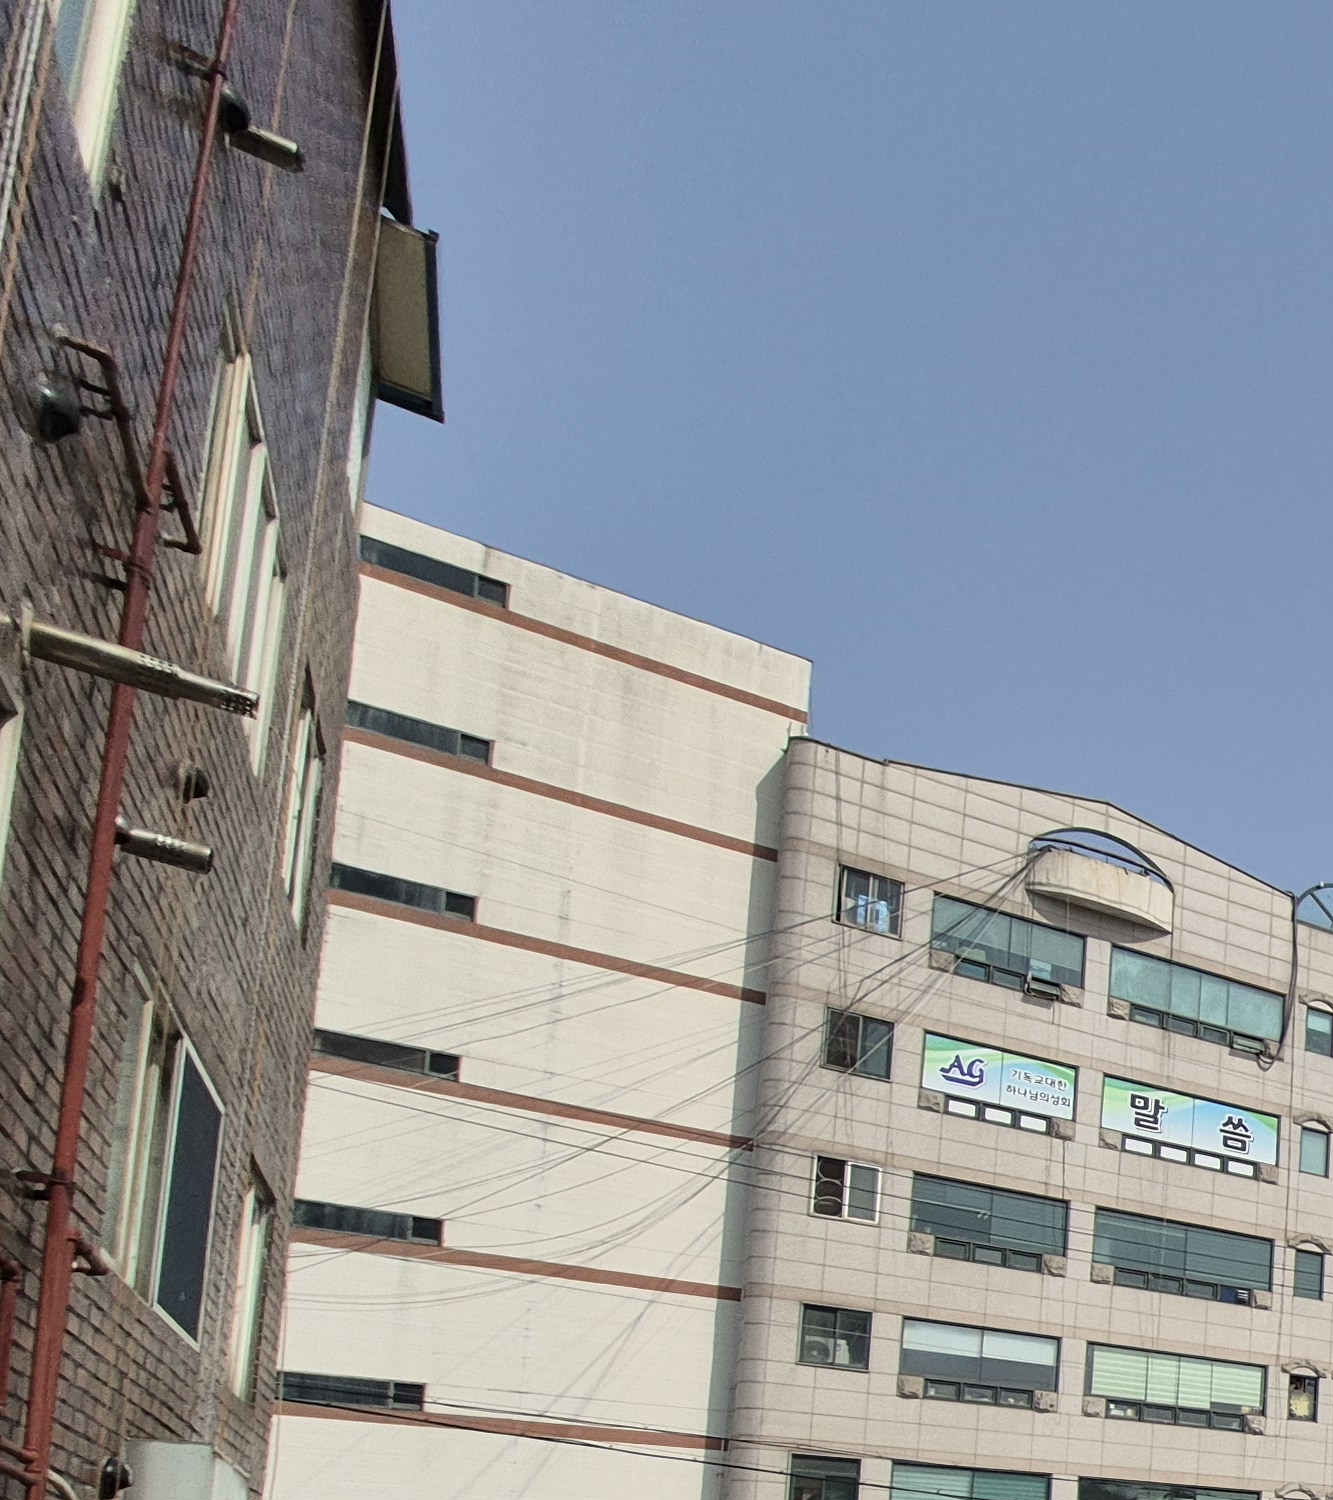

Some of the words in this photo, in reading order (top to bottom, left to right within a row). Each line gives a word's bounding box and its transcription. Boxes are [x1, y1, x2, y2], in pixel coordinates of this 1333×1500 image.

[940, 1055, 985, 1087] AG
[1011, 1070, 1068, 1091] 기독교대한
[1006, 1085, 1071, 1107] 하나님의성회
